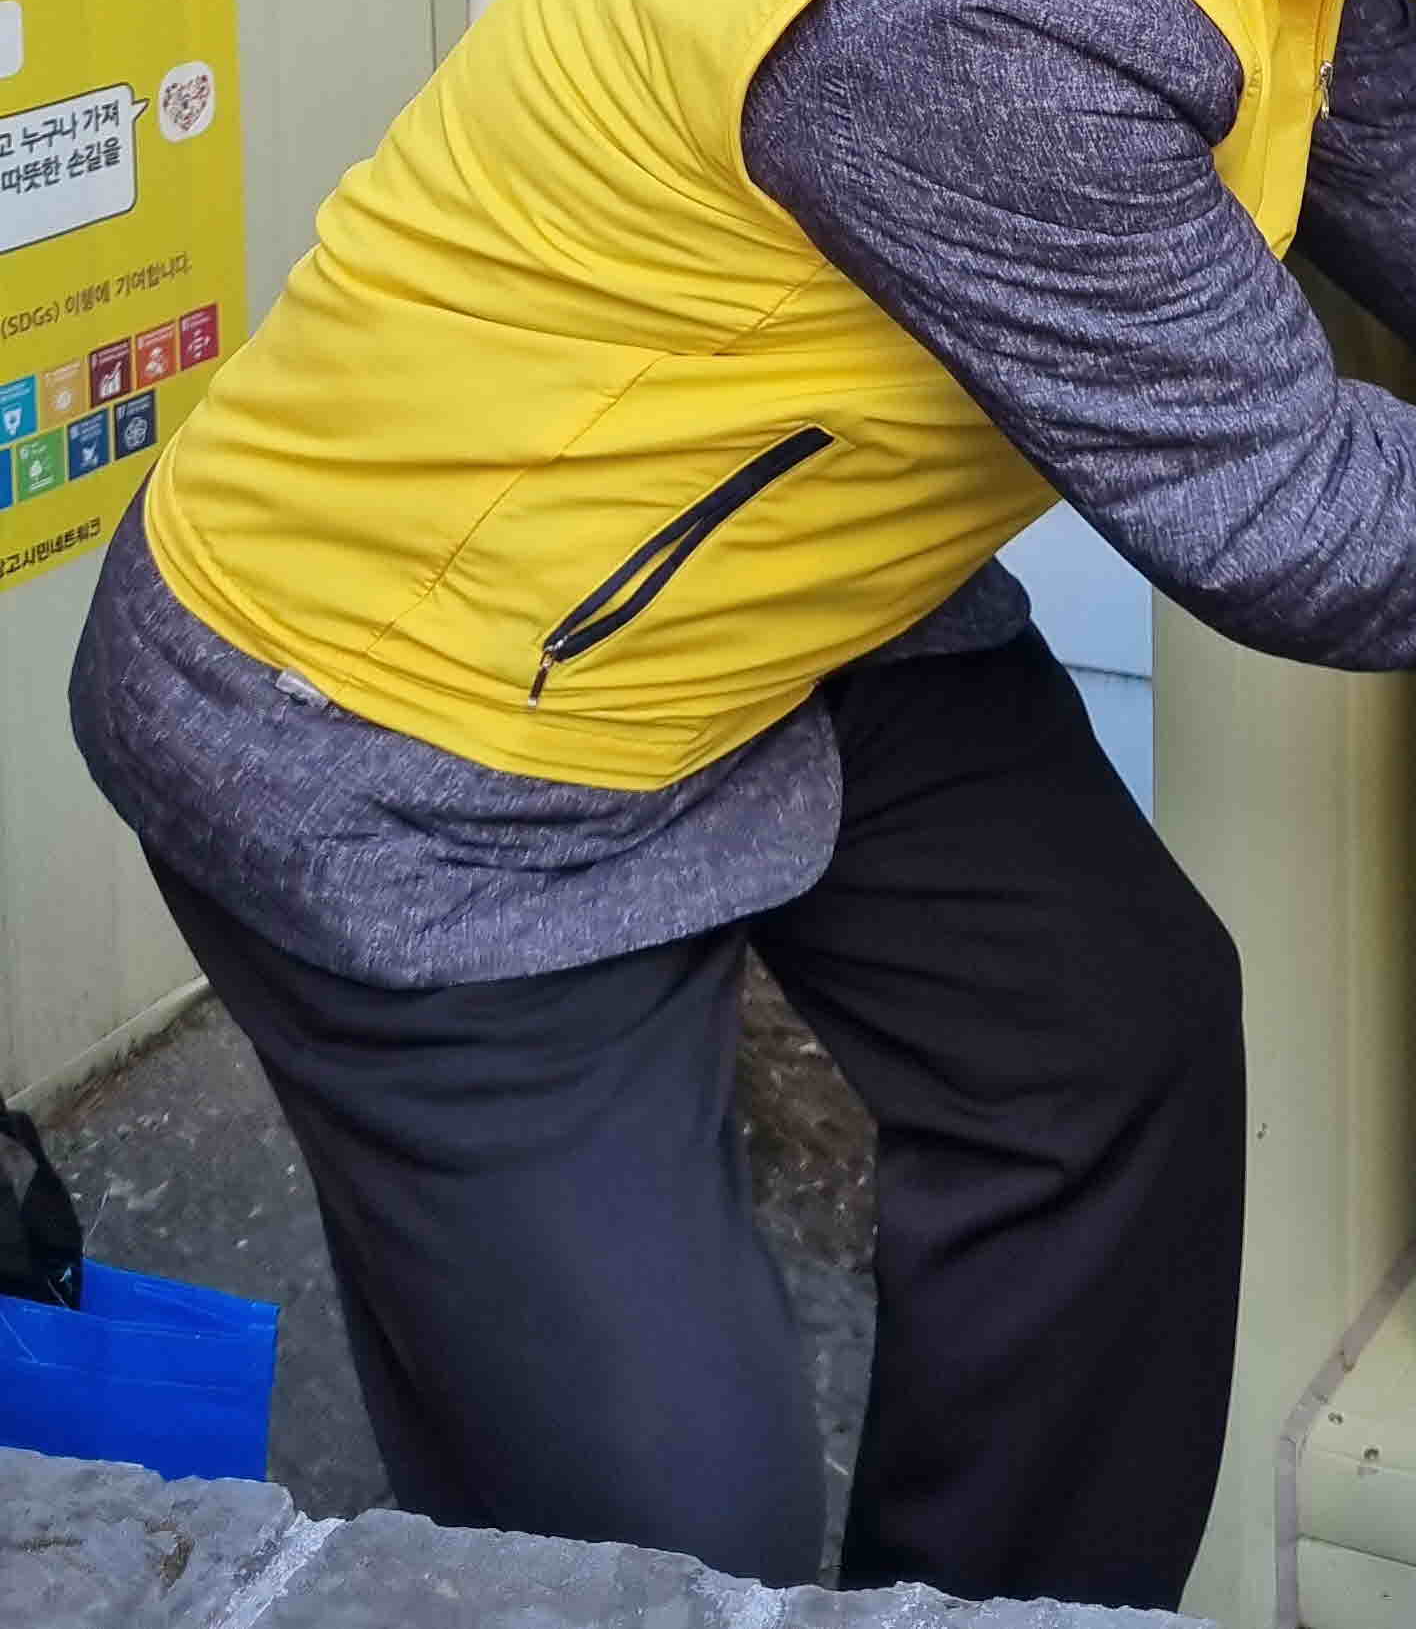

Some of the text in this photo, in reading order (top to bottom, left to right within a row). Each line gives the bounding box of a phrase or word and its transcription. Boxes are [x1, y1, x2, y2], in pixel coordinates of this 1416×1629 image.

[20, 111, 79, 154] 누구나
[81, 99, 120, 132] 가져
[0, 136, 122, 195] 따뜻한 손길을
[0, 299, 61, 340] (SDGs)
